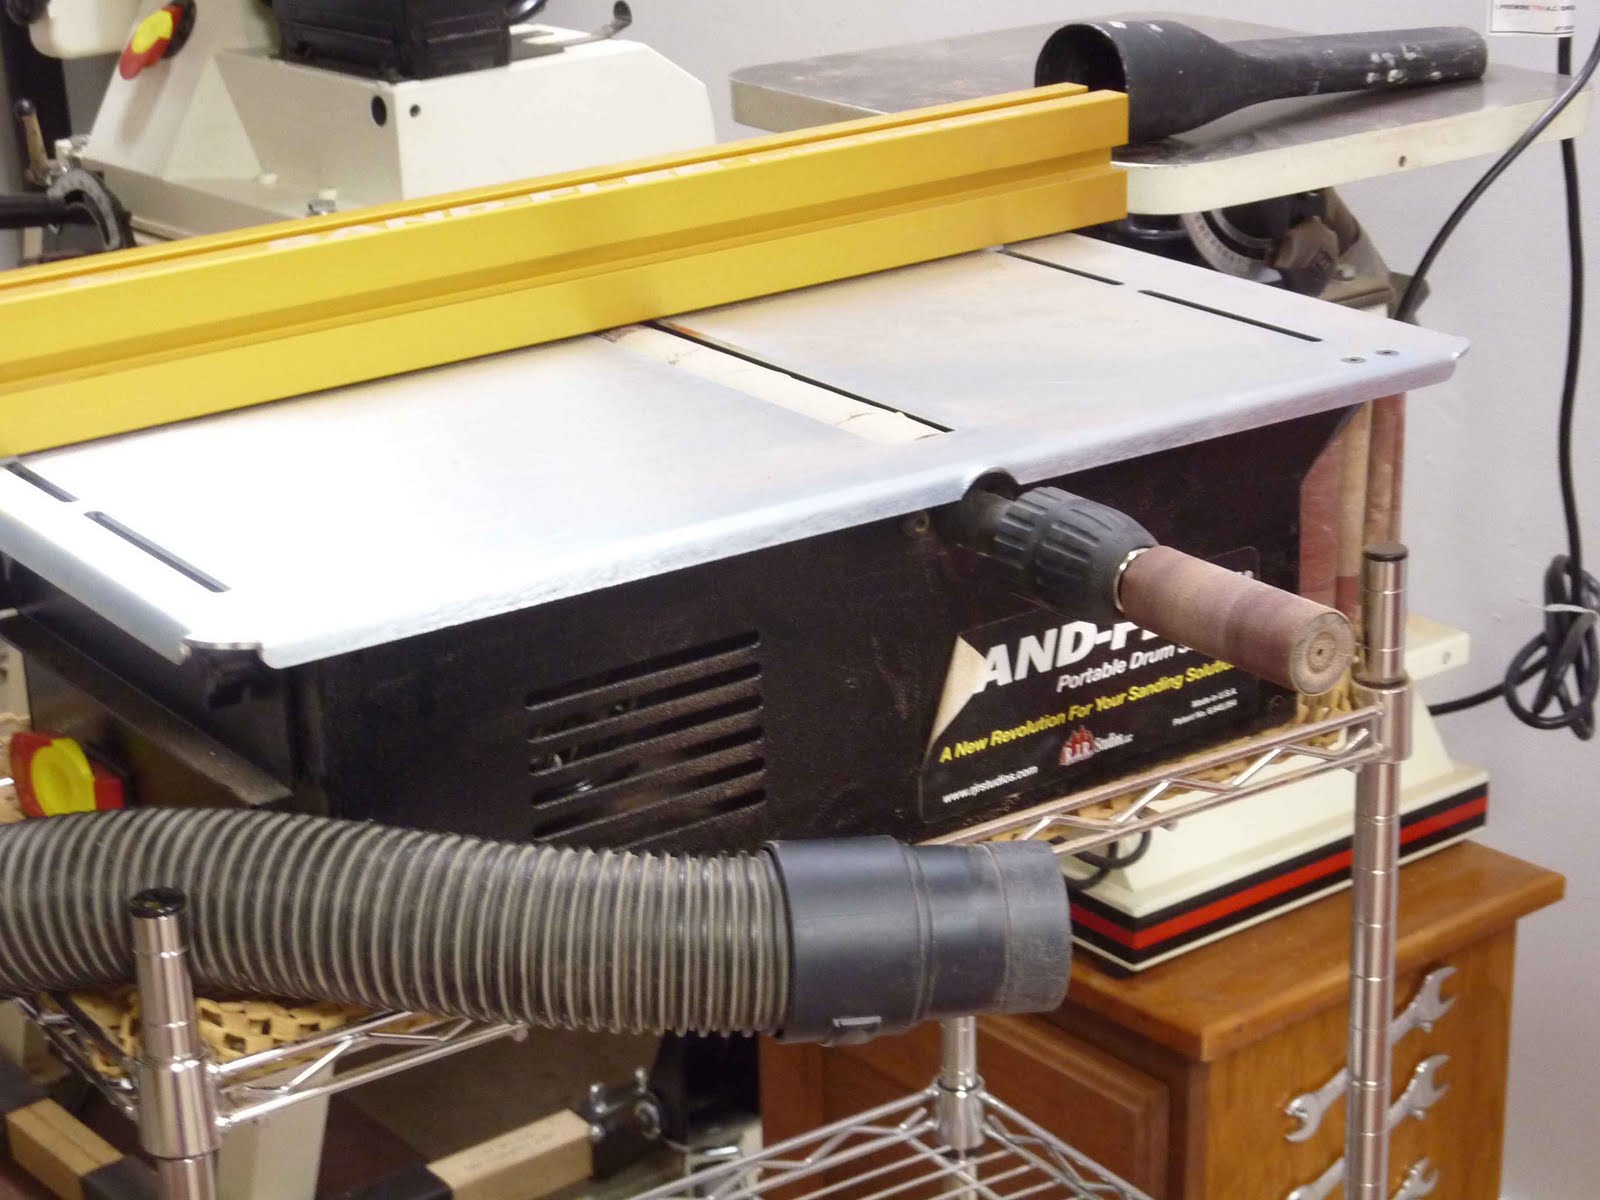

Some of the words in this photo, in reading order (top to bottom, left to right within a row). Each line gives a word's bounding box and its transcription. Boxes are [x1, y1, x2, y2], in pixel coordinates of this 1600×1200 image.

[1056, 658, 1127, 692] Portable
[1129, 645, 1175, 669] Drum
[939, 747, 953, 763] A
[954, 738, 988, 758] New
[990, 713, 1066, 746] Revolution
[1068, 703, 1094, 721] For
[1095, 693, 1128, 713] Your
[1128, 674, 1184, 701] Sanding
